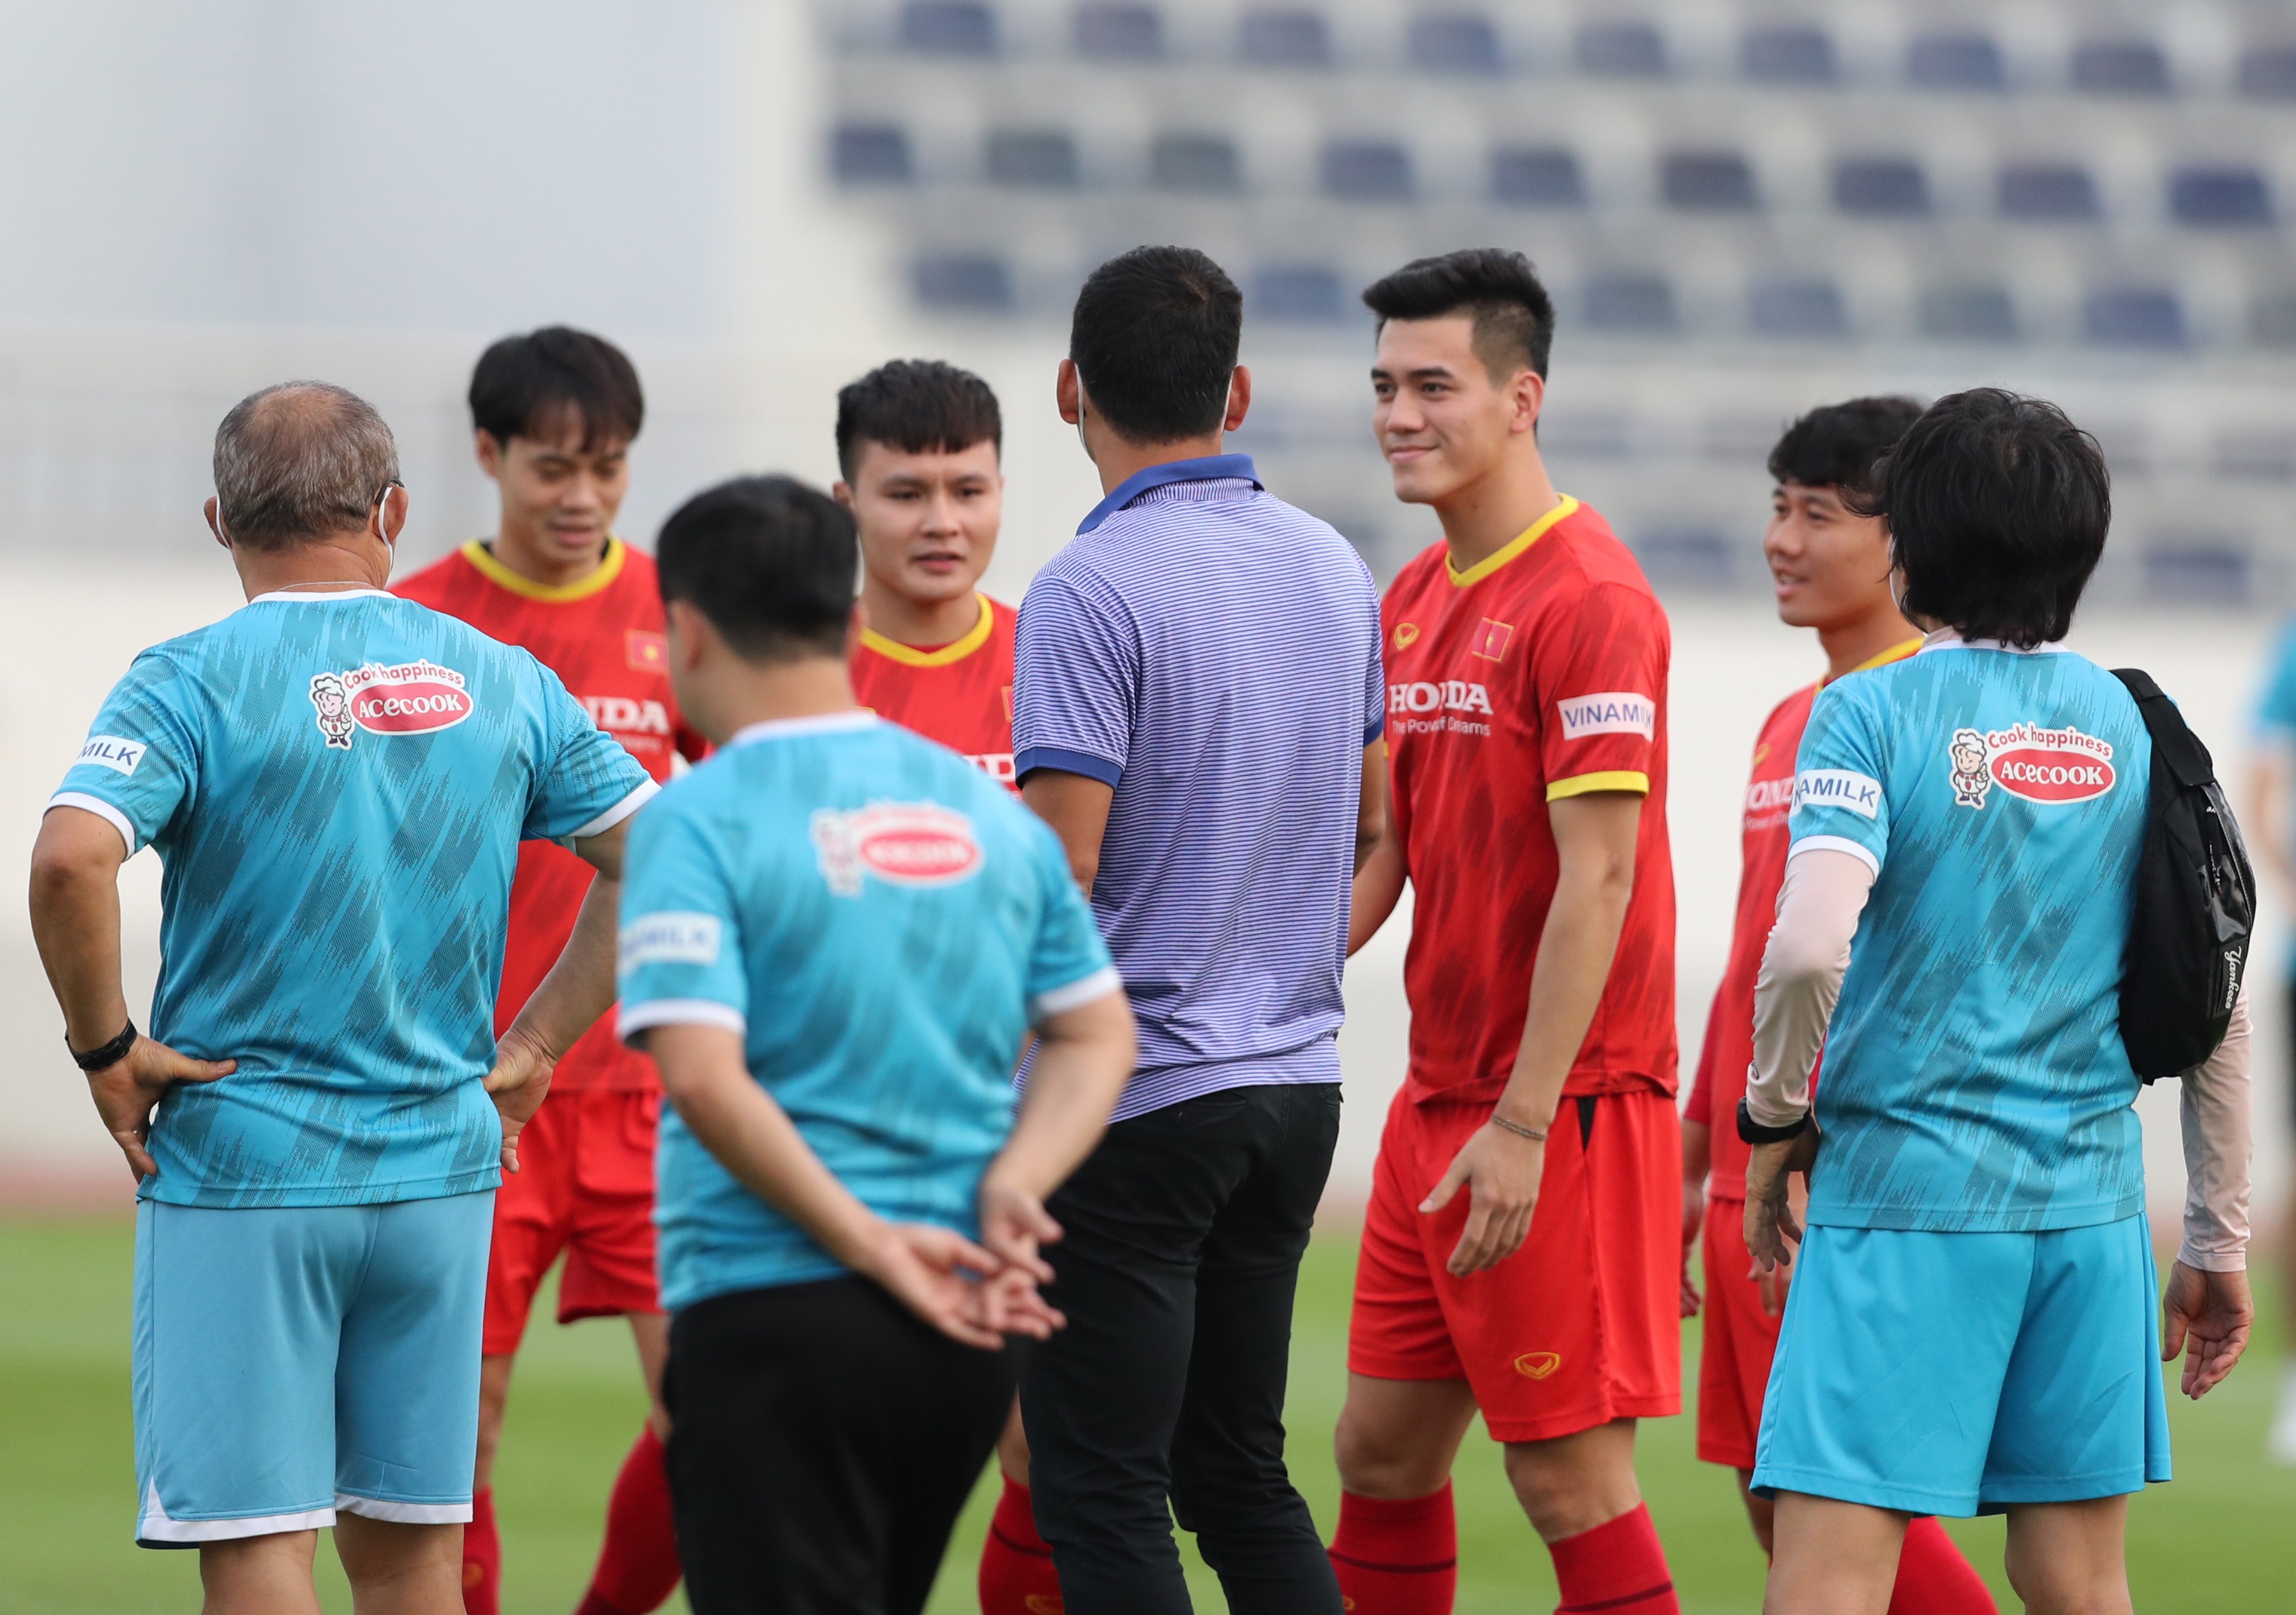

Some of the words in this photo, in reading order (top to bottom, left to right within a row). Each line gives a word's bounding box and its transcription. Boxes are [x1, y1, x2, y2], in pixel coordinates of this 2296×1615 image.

[344, 665, 378, 689] Cook
[378, 663, 461, 685] happiness
[1565, 703, 1651, 730] VINAMILK
[1989, 726, 2027, 749] Cook
[2031, 725, 2110, 756] happiness
[2224, 946, 2242, 1009] Yankees
